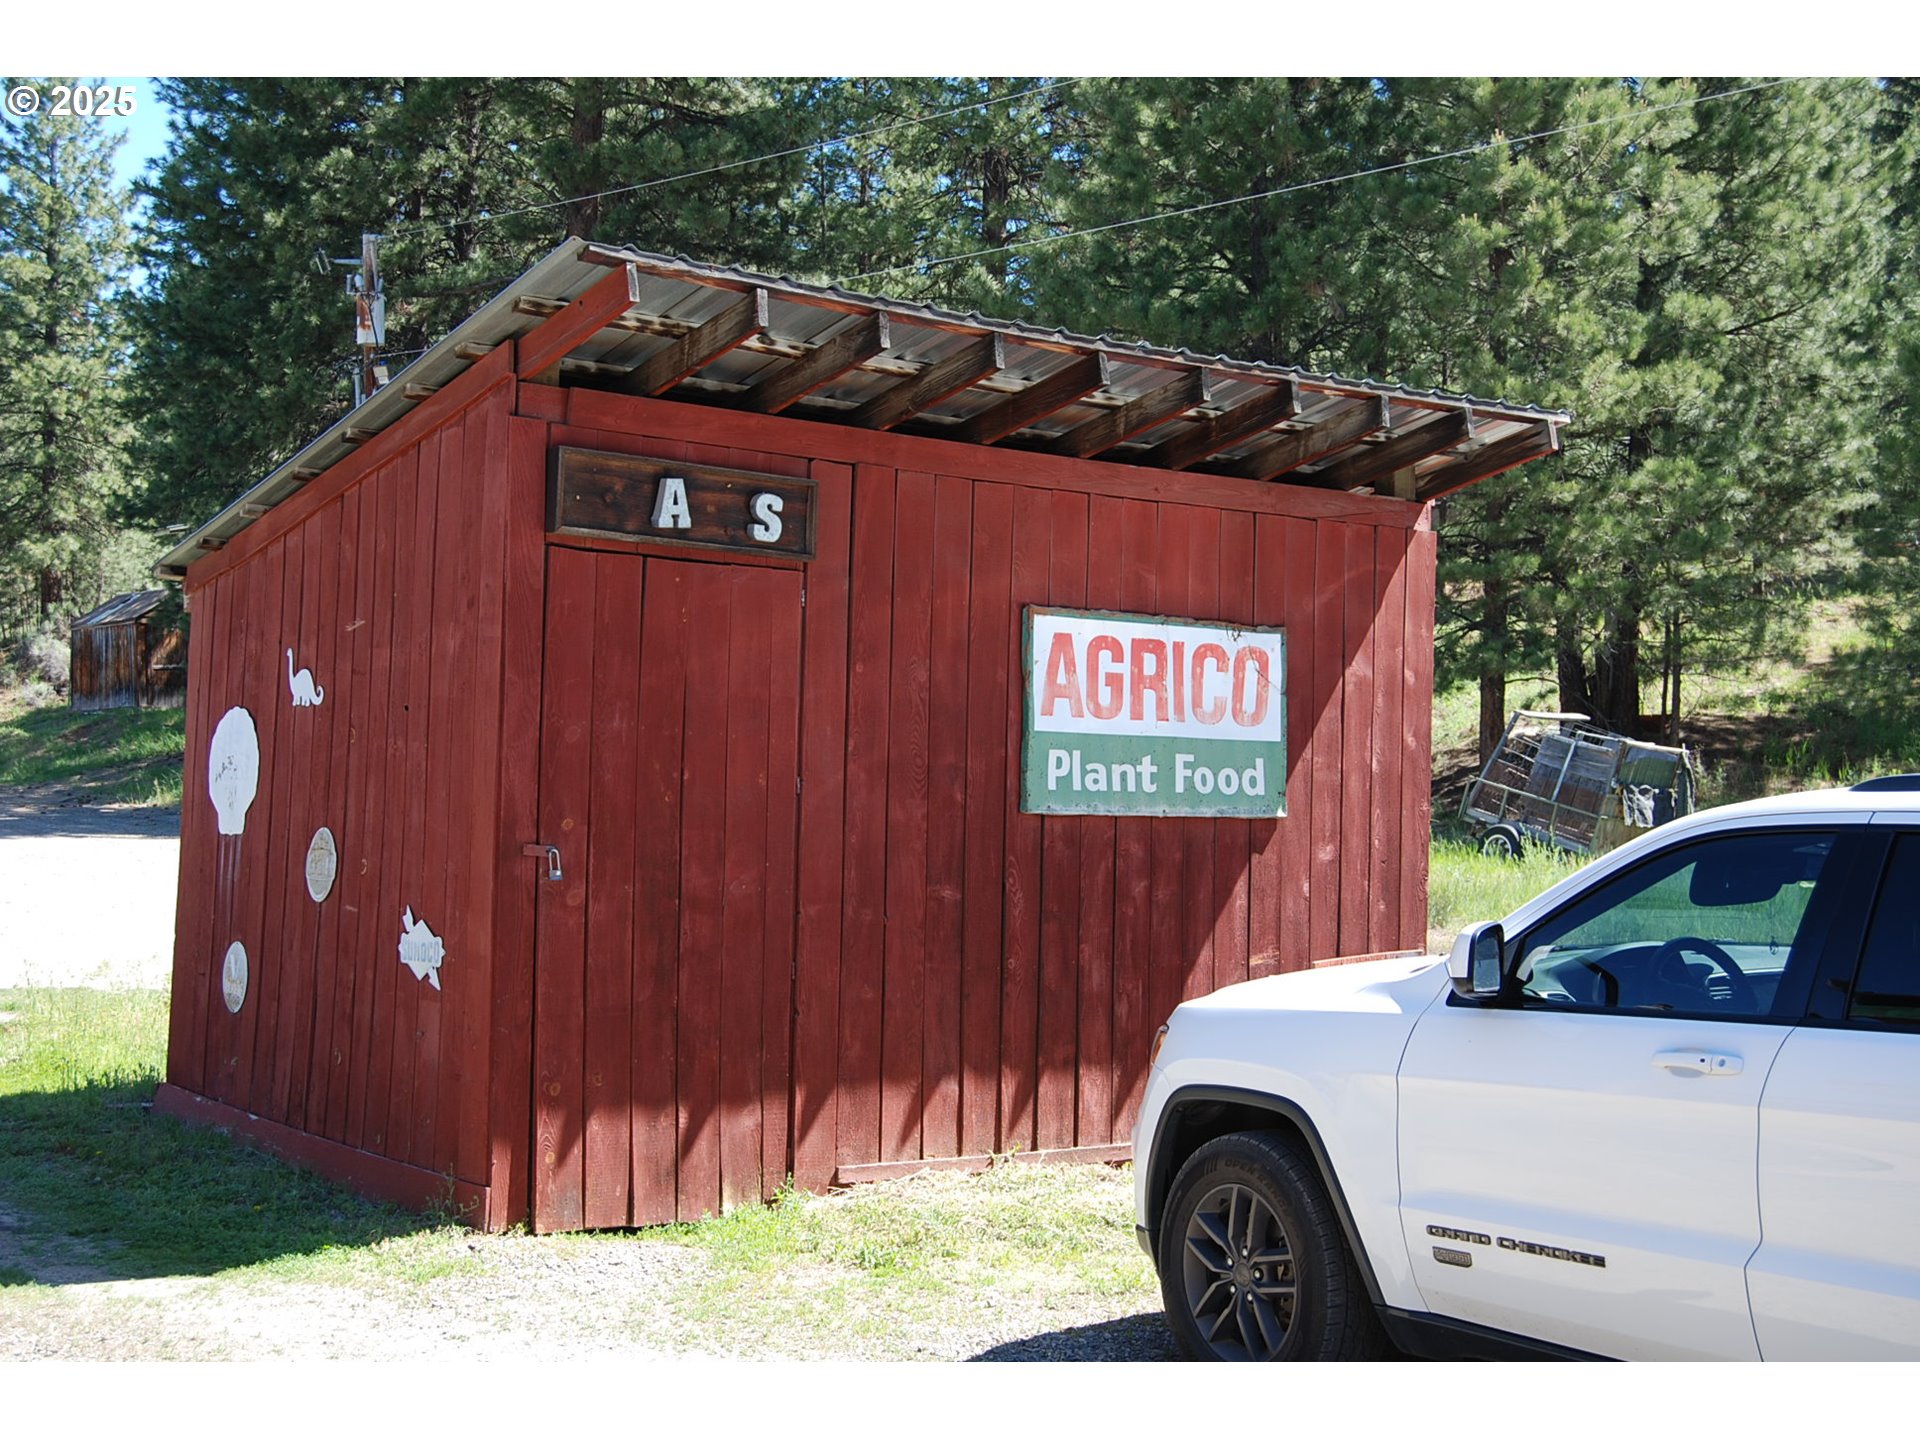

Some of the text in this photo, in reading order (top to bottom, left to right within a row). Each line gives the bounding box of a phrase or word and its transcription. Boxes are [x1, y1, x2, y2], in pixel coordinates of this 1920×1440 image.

[1040, 632, 1270, 727] AGRICO
[1047, 749, 1265, 795] Plant Food
[1426, 1224, 1491, 1246] GRAND
[1496, 1236, 1606, 1268] CHEROKEE
